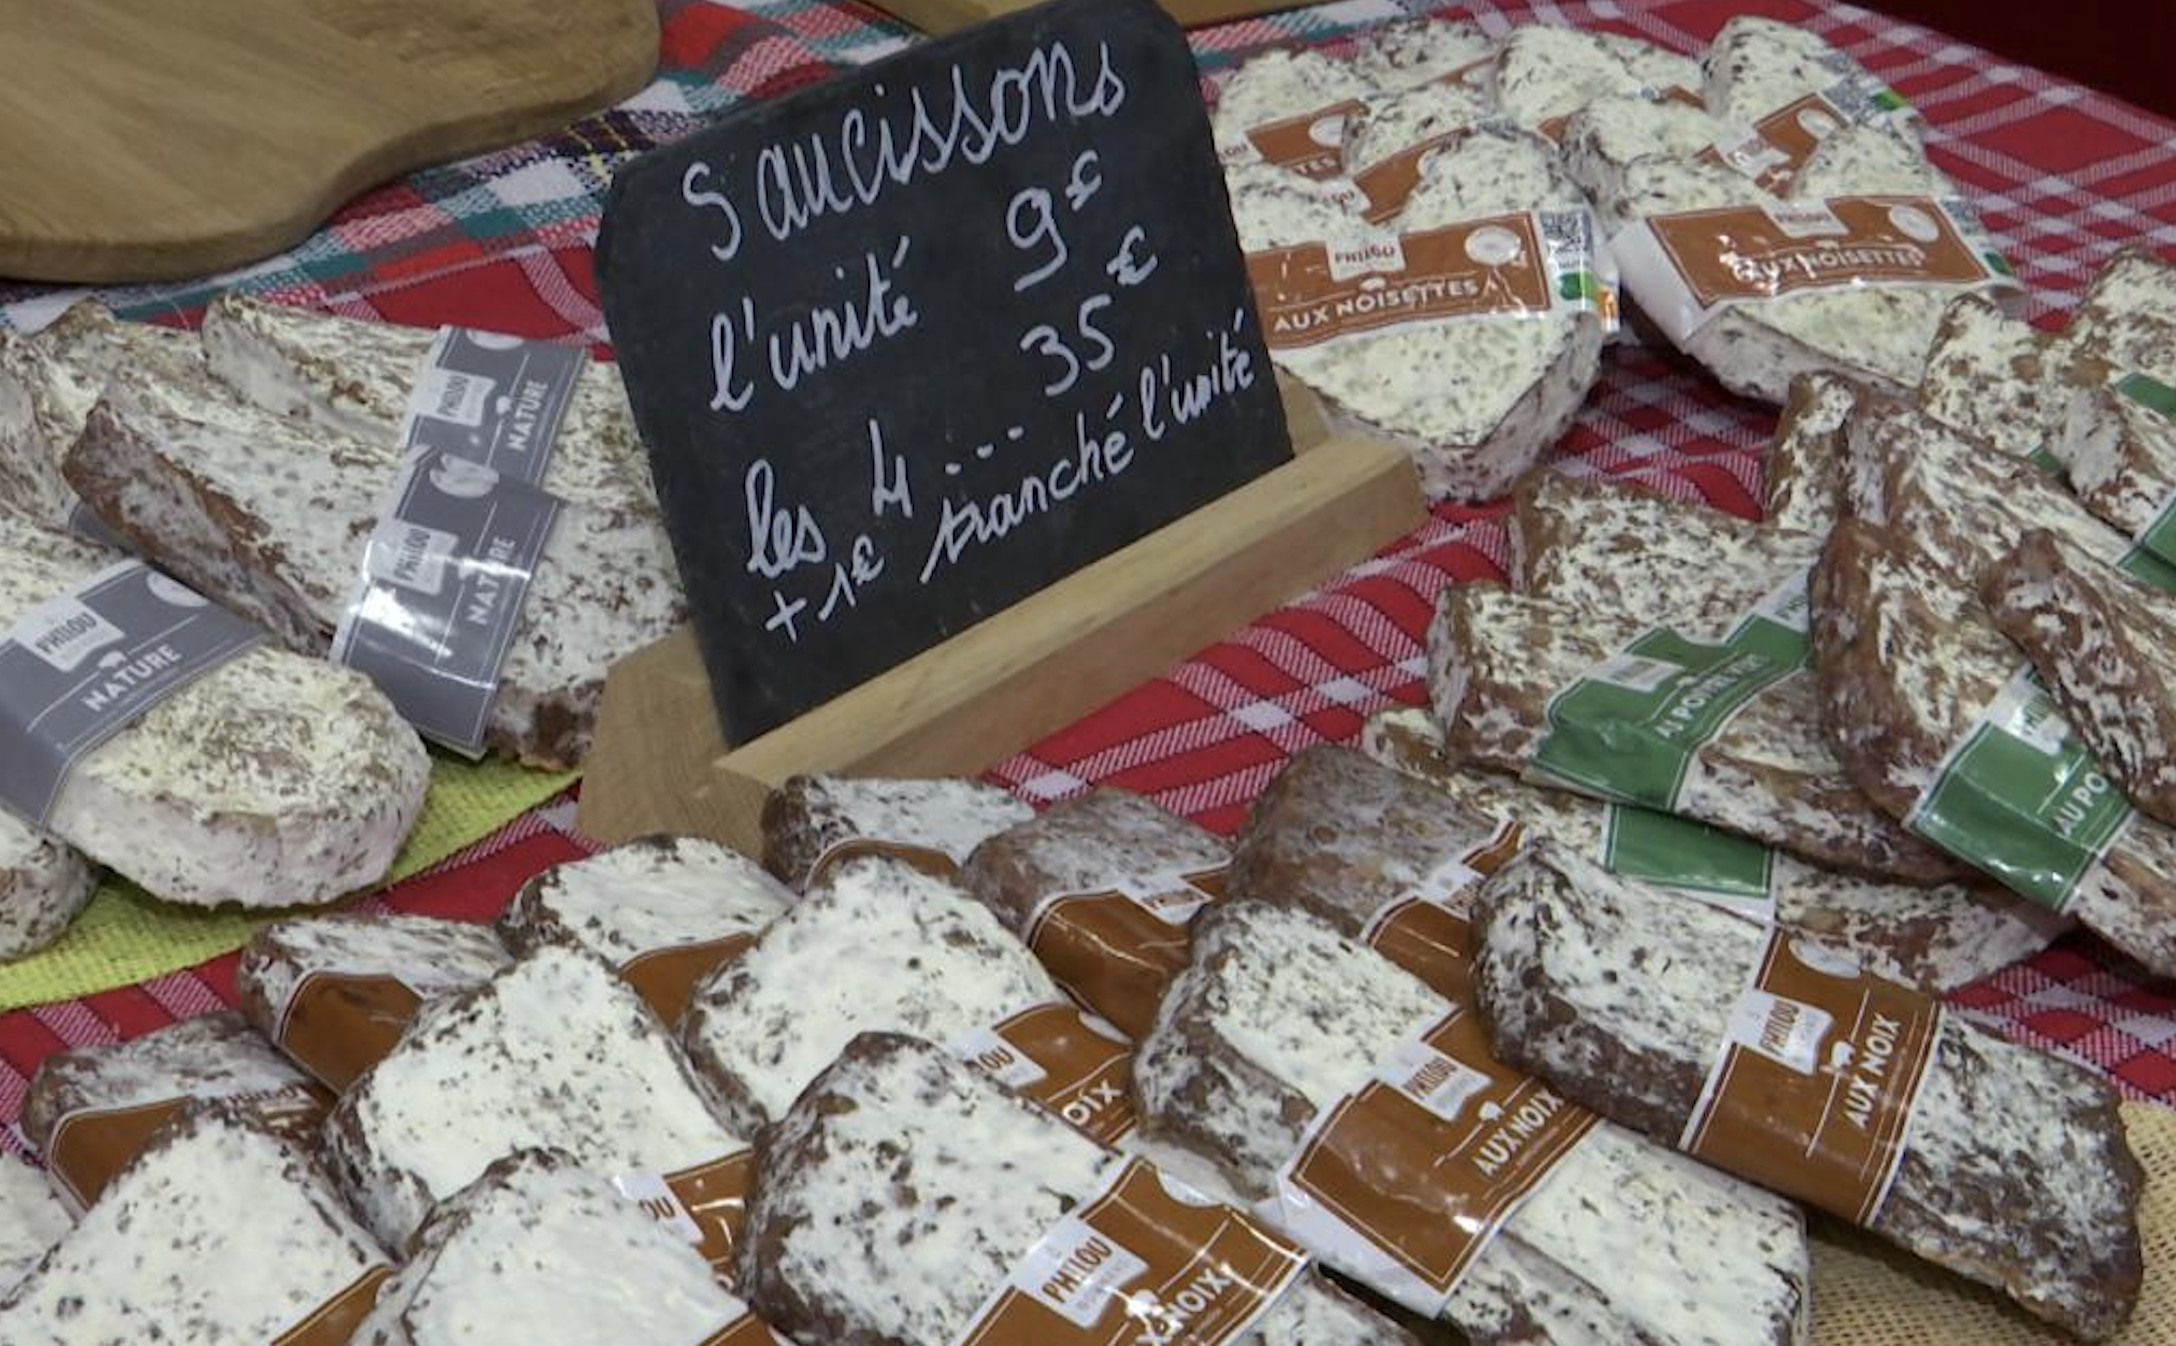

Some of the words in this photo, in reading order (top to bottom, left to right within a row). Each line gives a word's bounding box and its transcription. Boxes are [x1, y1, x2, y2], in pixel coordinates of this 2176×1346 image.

[682, 40, 1125, 262] Saucissons
[709, 236, 920, 411] l'unité
[1272, 305, 1330, 333] AUX
[1335, 277, 1480, 319] NOISETTES
[507, 380, 549, 452] NATURE
[920, 392, 1135, 584] tranché
[1139, 308, 1256, 440] l'unité
[746, 458, 828, 578] les
[869, 418, 913, 519] 4
[467, 536, 517, 626] NATRE
[81, 643, 183, 713] NATURE
[2053, 800, 2086, 838] AU
[1858, 1011, 1902, 1077] NOIX
[1472, 1127, 1524, 1178] AUX
[1508, 1087, 1566, 1139] NOIX
[1844, 1075, 1879, 1131] AUX
[1042, 1235, 1114, 1304] PHILOU
